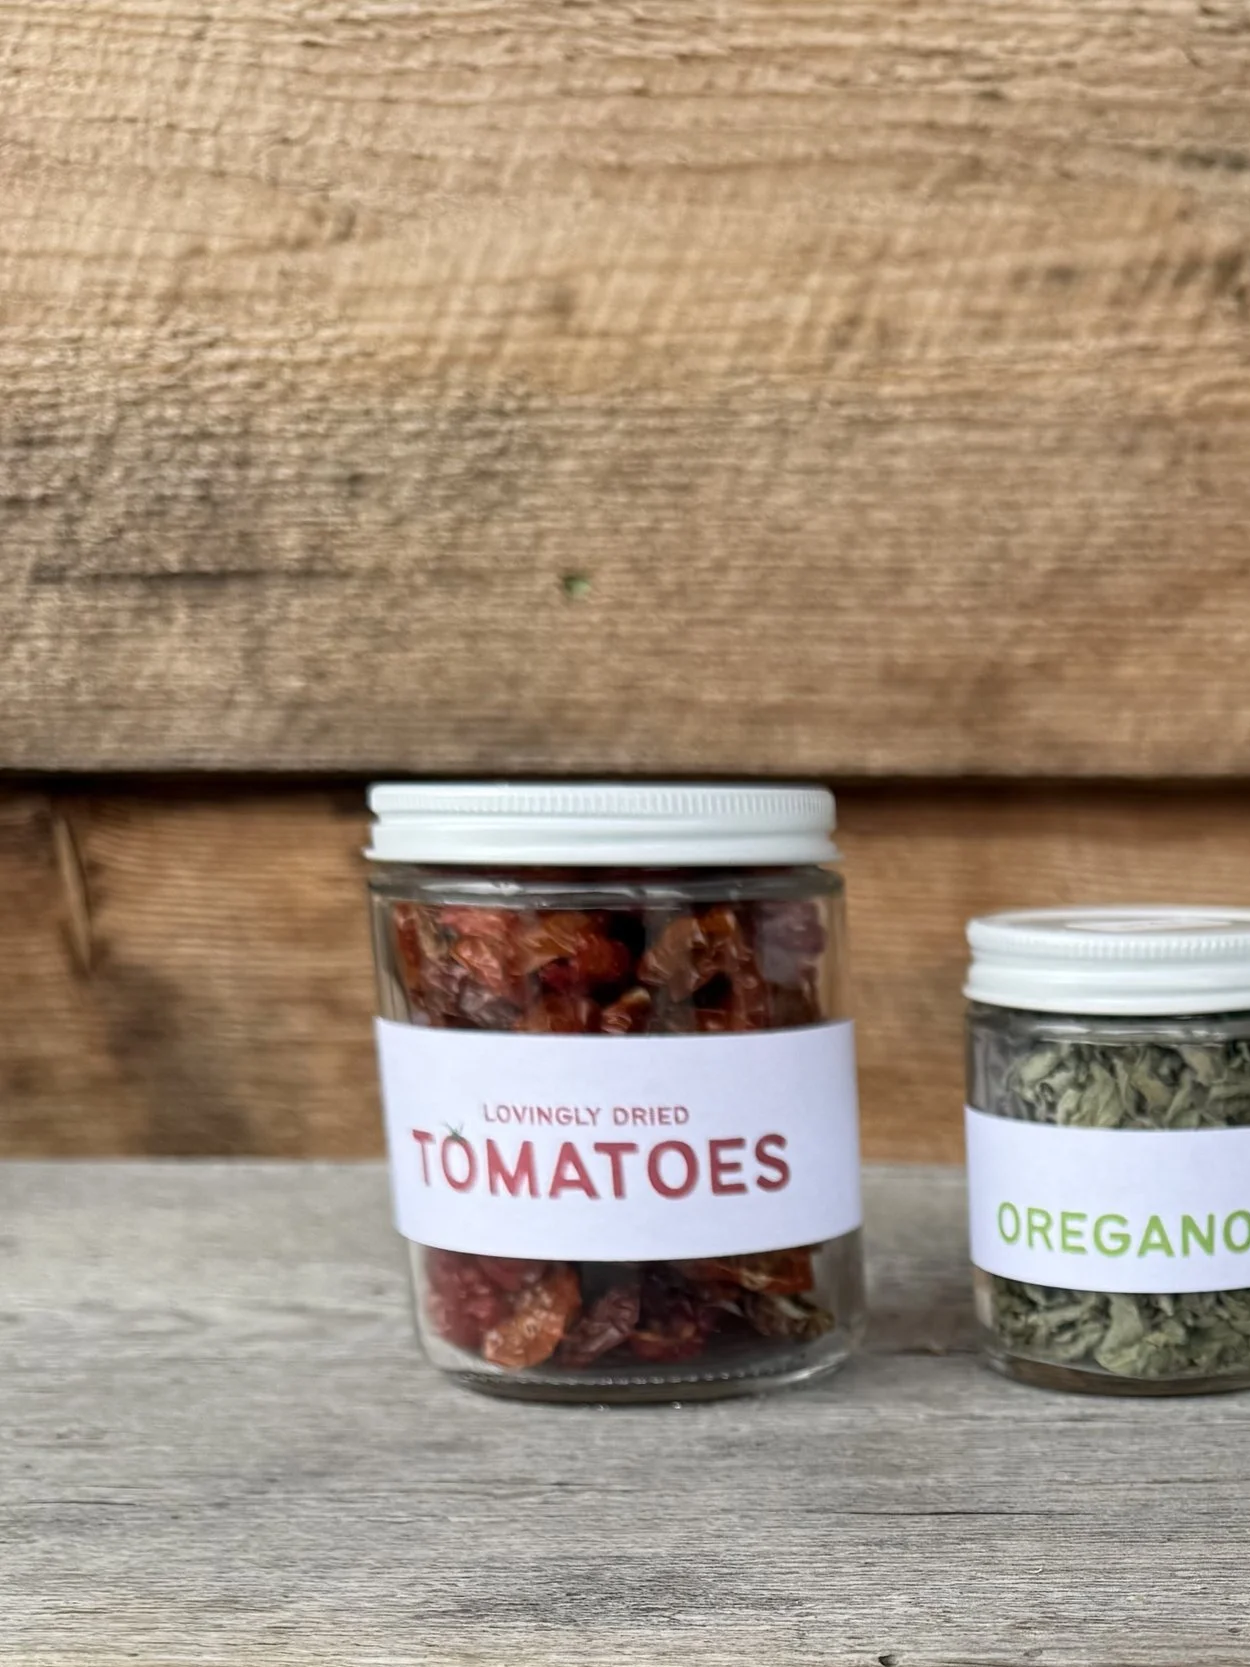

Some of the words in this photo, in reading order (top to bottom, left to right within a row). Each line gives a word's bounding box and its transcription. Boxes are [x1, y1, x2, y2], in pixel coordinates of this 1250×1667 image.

[482, 1104, 600, 1126] LOVINGLY
[612, 1106, 690, 1126] DRIED
[411, 1128, 791, 1200] TOMATOES
